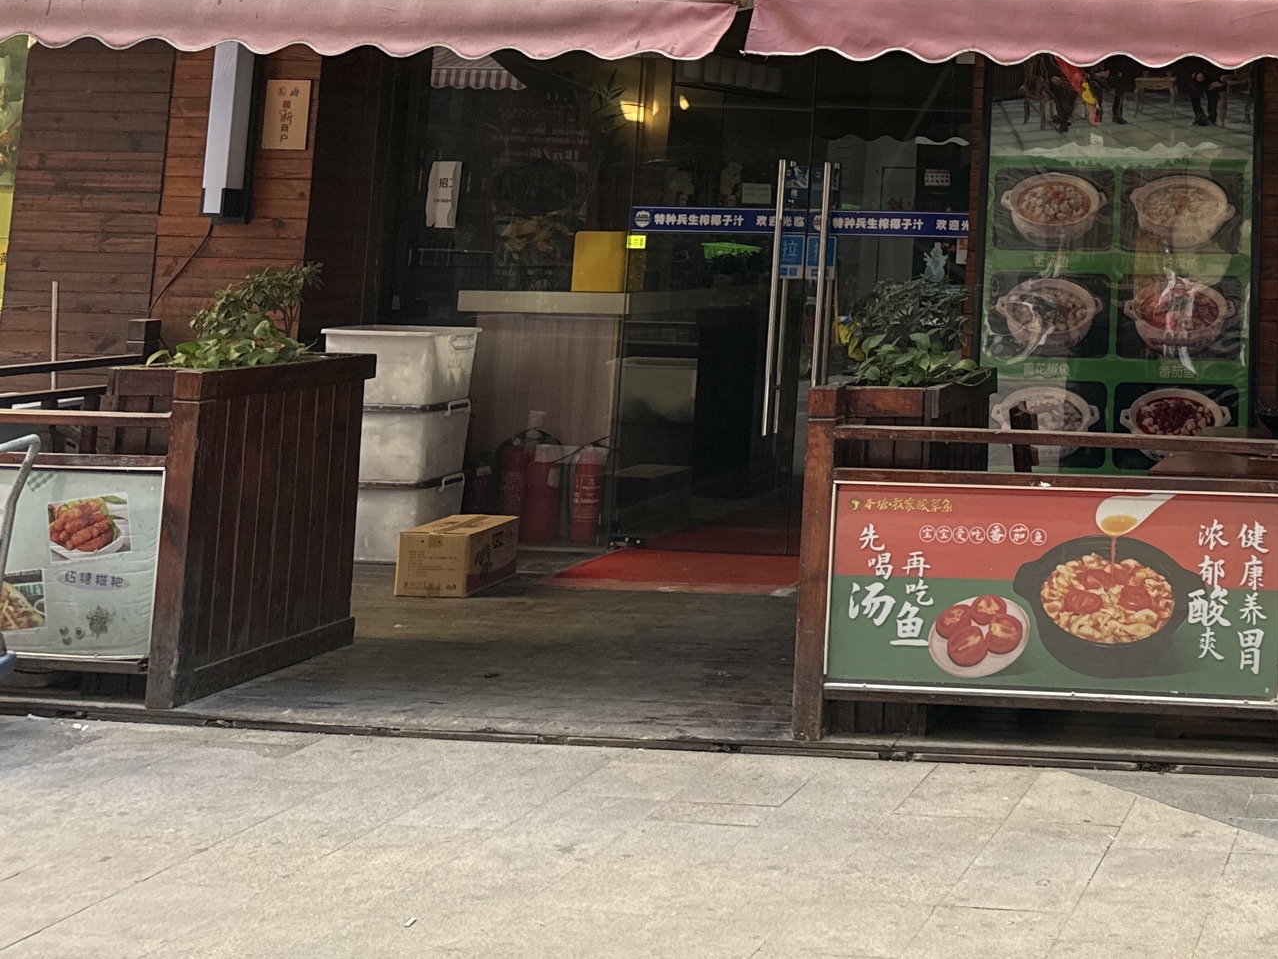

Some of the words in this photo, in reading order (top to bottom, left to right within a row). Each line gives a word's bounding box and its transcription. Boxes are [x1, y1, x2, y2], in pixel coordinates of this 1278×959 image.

[654, 213, 744, 227] 特种兵生榨椰子汁
[832, 216, 924, 230] 特种兵生榨椰子汁
[782, 240, 798, 257] 拉
[1158, 365, 1196, 378] 番茄鱼
[919, 523, 1047, 546] 宝宝爱吃番茄鱼
[65, 571, 123, 587] 红糖糍粑
[848, 523, 896, 626] 先喝汤
[890, 551, 934, 646] 再吃鱼
[1188, 519, 1232, 660] 浓郁酸爽
[1237, 520, 1270, 675] 健康养胃
